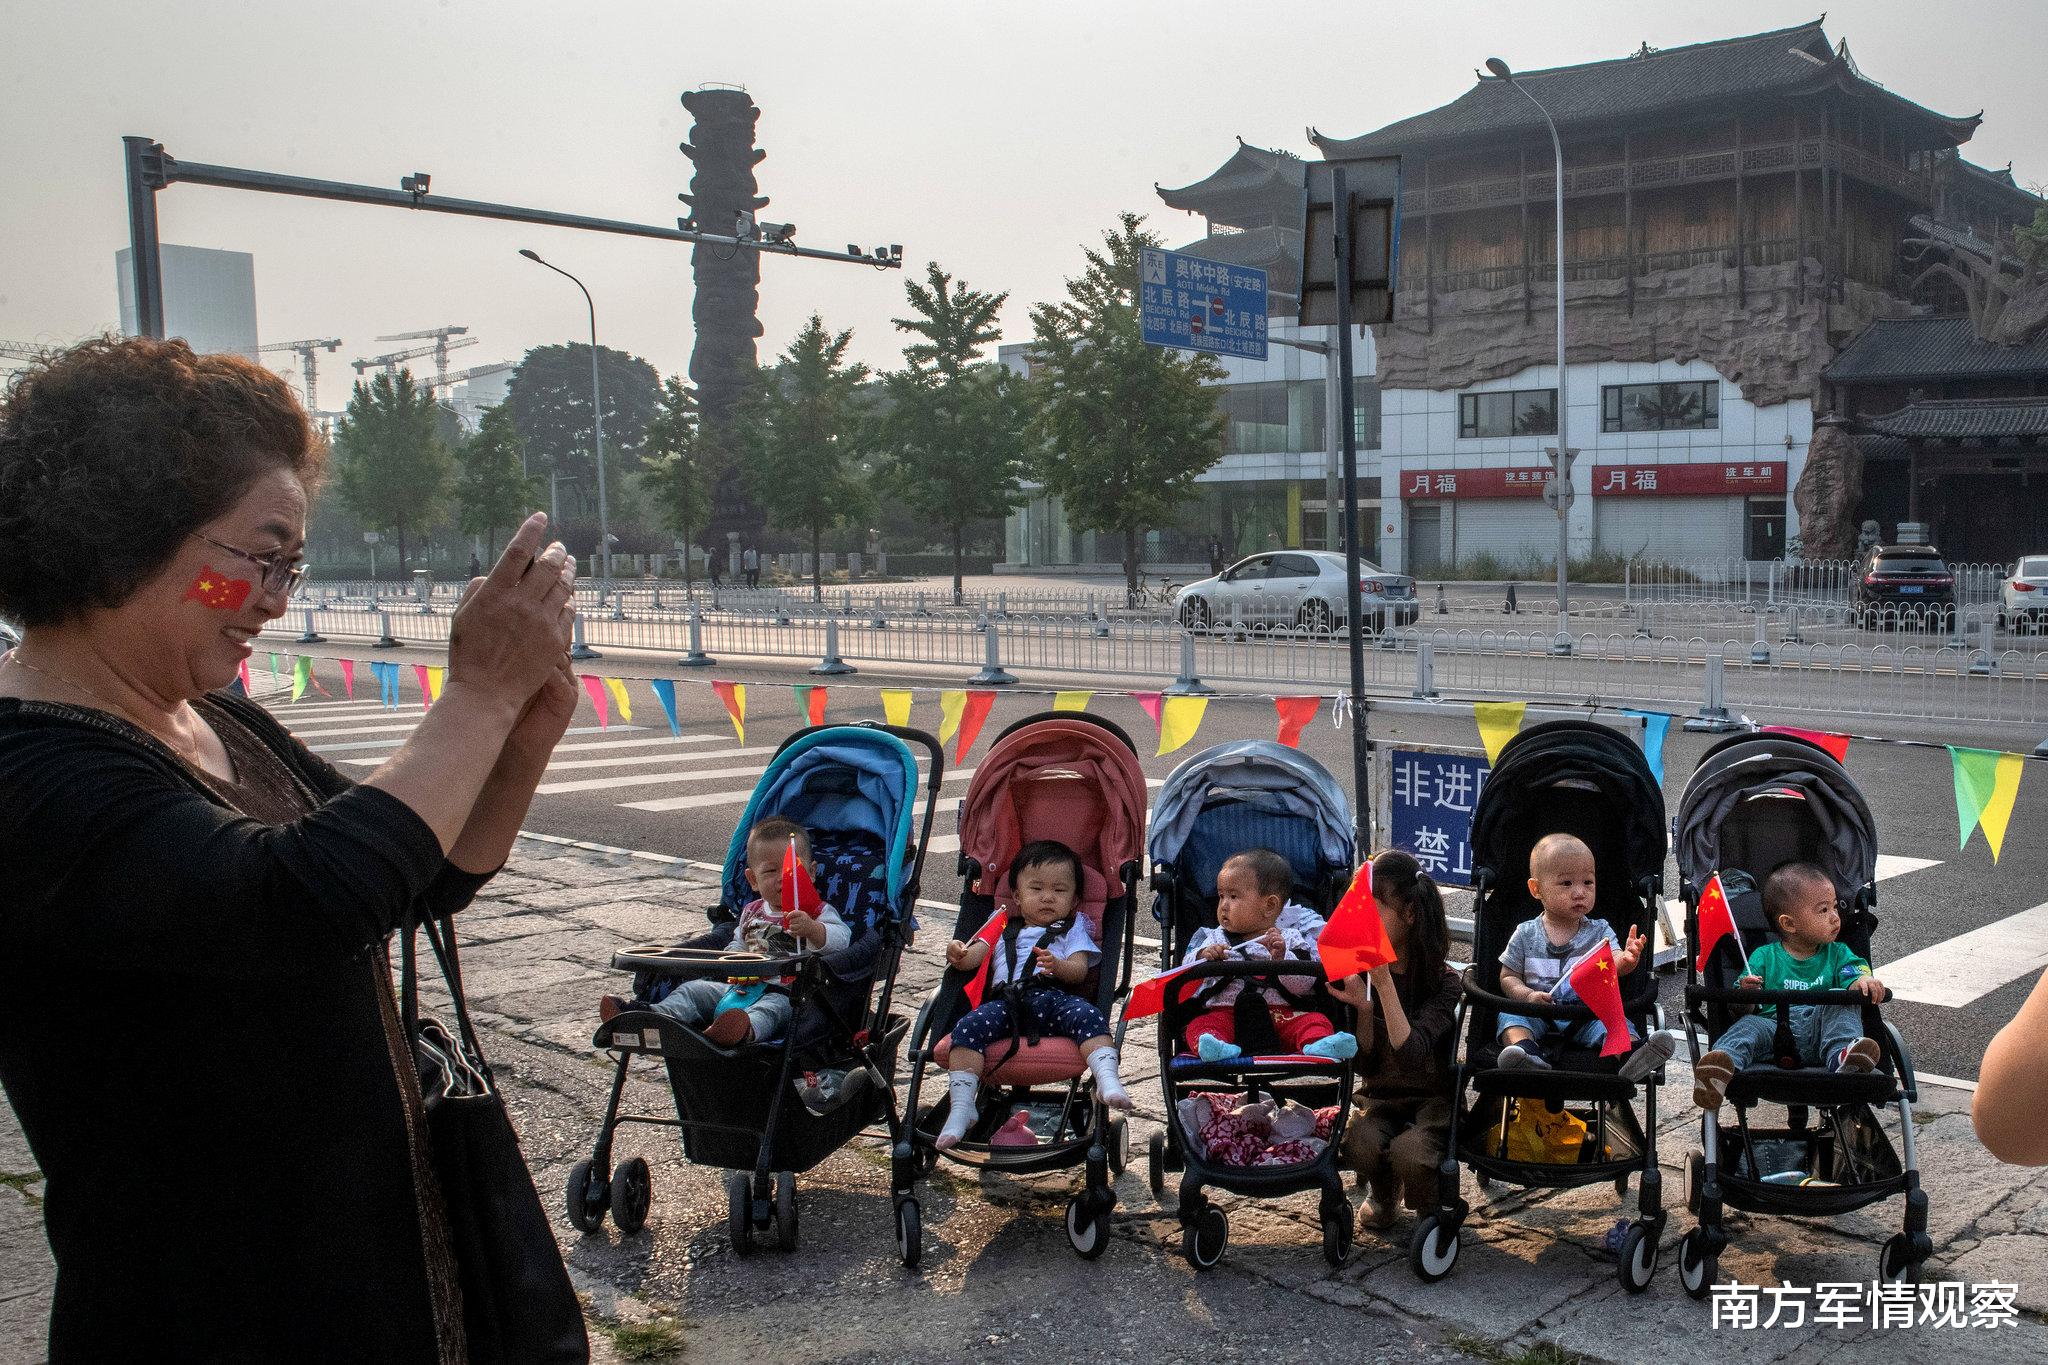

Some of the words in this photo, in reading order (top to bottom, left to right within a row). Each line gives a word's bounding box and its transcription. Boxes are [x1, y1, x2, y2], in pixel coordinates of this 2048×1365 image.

[1221, 287, 1231, 297] Rd
[1145, 304, 1176, 318] BEICHEN
[1179, 310, 1189, 320] Rd
[1224, 327, 1254, 339] BEICHEN
[1256, 332, 1265, 341] Rd
[1725, 466, 1772, 477] 洗车机
[1409, 474, 1457, 494] 月福
[1602, 470, 1657, 491] 月福
[1783, 979, 1809, 990] SUPER
